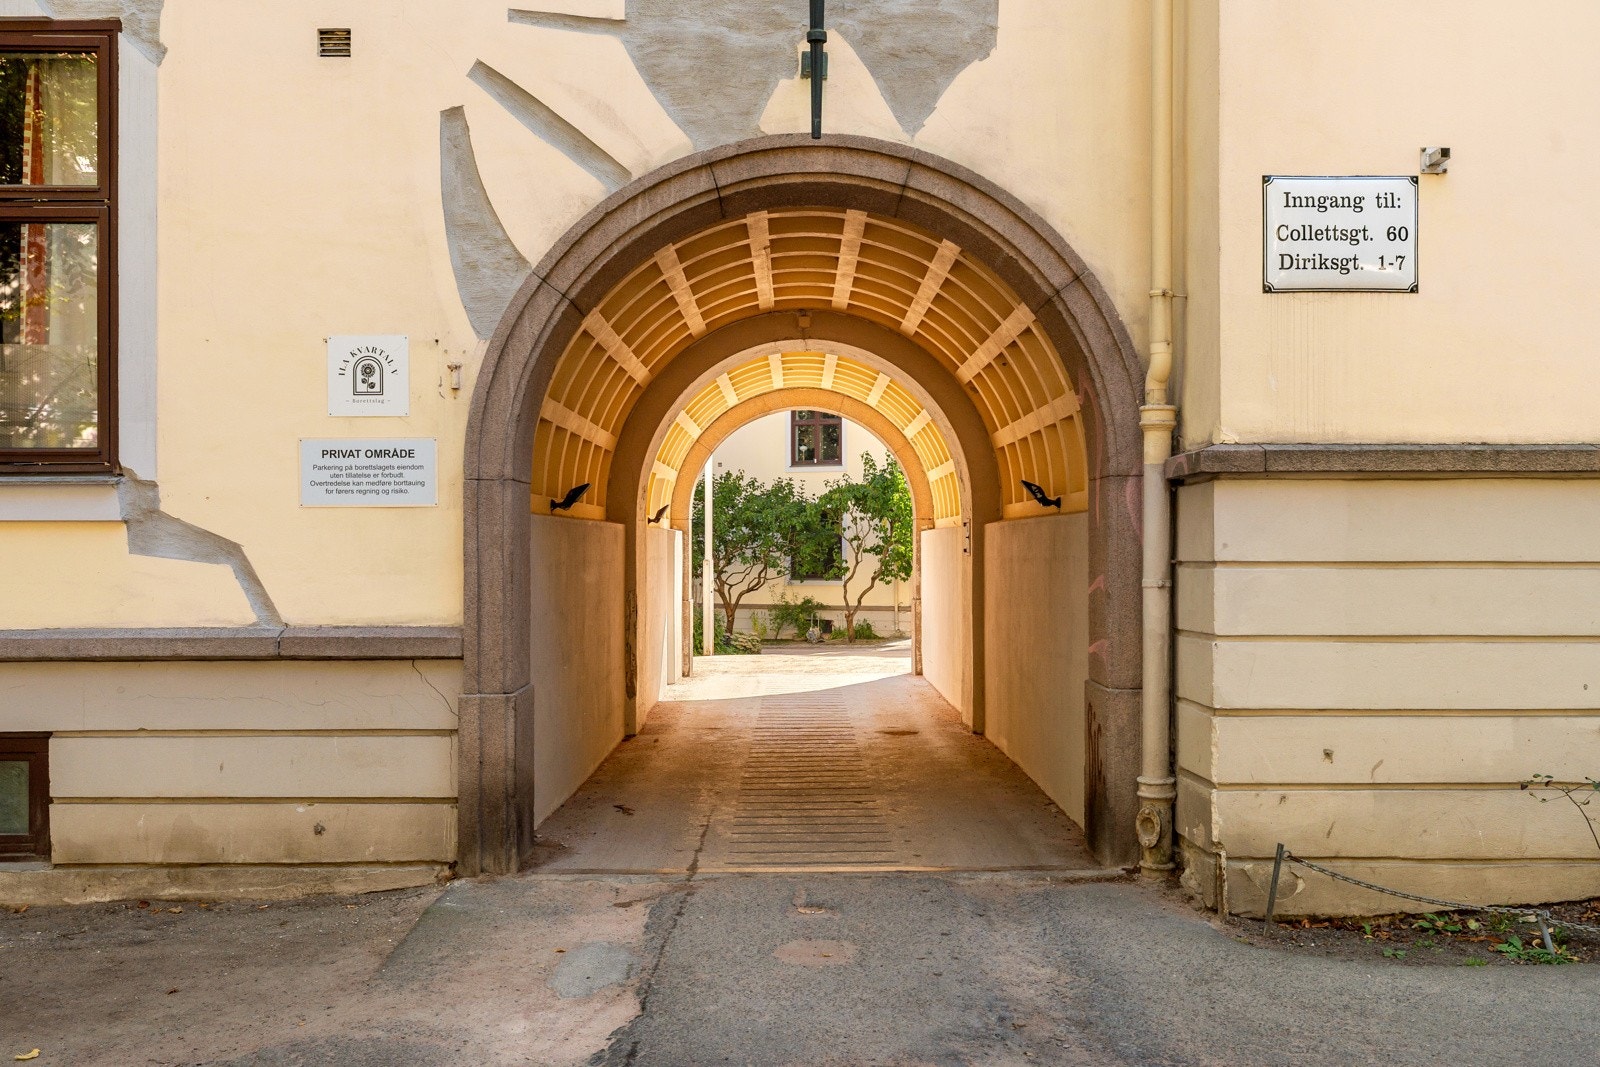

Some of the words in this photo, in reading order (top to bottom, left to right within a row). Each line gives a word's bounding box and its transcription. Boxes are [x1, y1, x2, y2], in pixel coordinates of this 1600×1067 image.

[1283, 191, 1366, 213] Inngang
[1375, 192, 1401, 209] til:
[1276, 224, 1374, 246] Collettsgt.
[1386, 226, 1409, 242] 60
[1278, 253, 1364, 275] Diriksgt.
[1378, 255, 1406, 271] 1-7
[338, 359, 350, 376] ILA
[349, 346, 394, 367] KVARTAL
[321, 449, 362, 459] PRIVAT
[364, 448, 415, 459] OMRÅDE
[312, 464, 343, 472] Parkering
[344, 464, 353, 472] på
[354, 464, 396, 472] borettslagets
[356, 488, 380, 496] regning
[393, 480, 426, 488] borttauing
